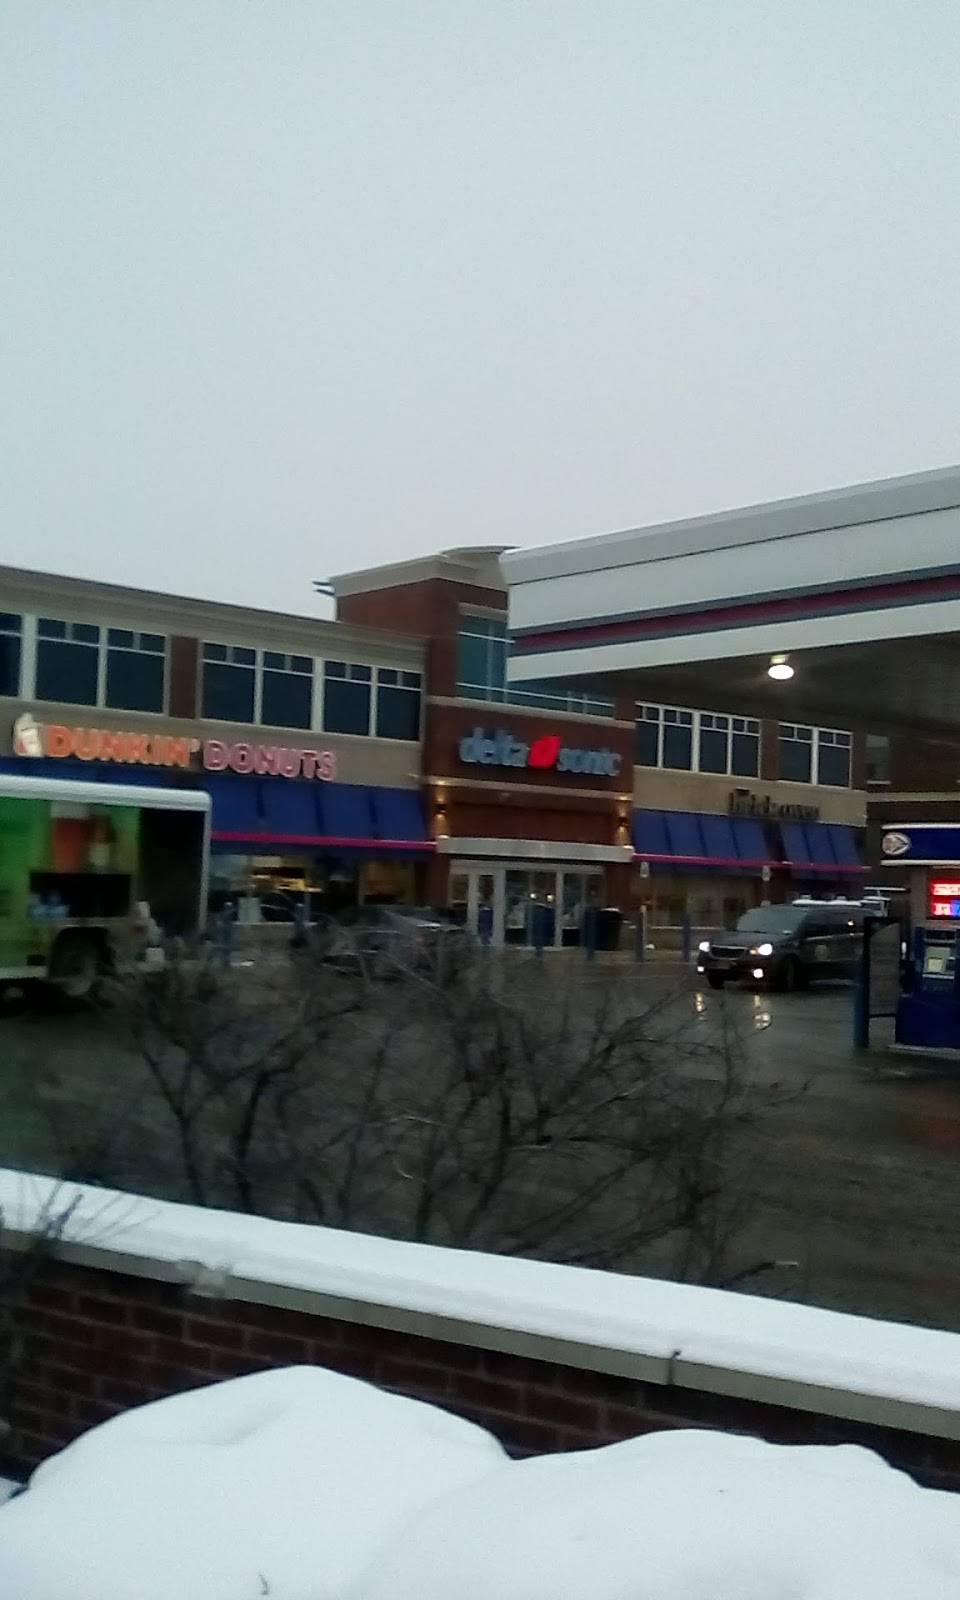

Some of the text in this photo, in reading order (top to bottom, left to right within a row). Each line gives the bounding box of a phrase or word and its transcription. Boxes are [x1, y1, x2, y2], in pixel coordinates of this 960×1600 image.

[202, 739, 337, 782] DONUTS
[459, 727, 622, 776] delta sonic
